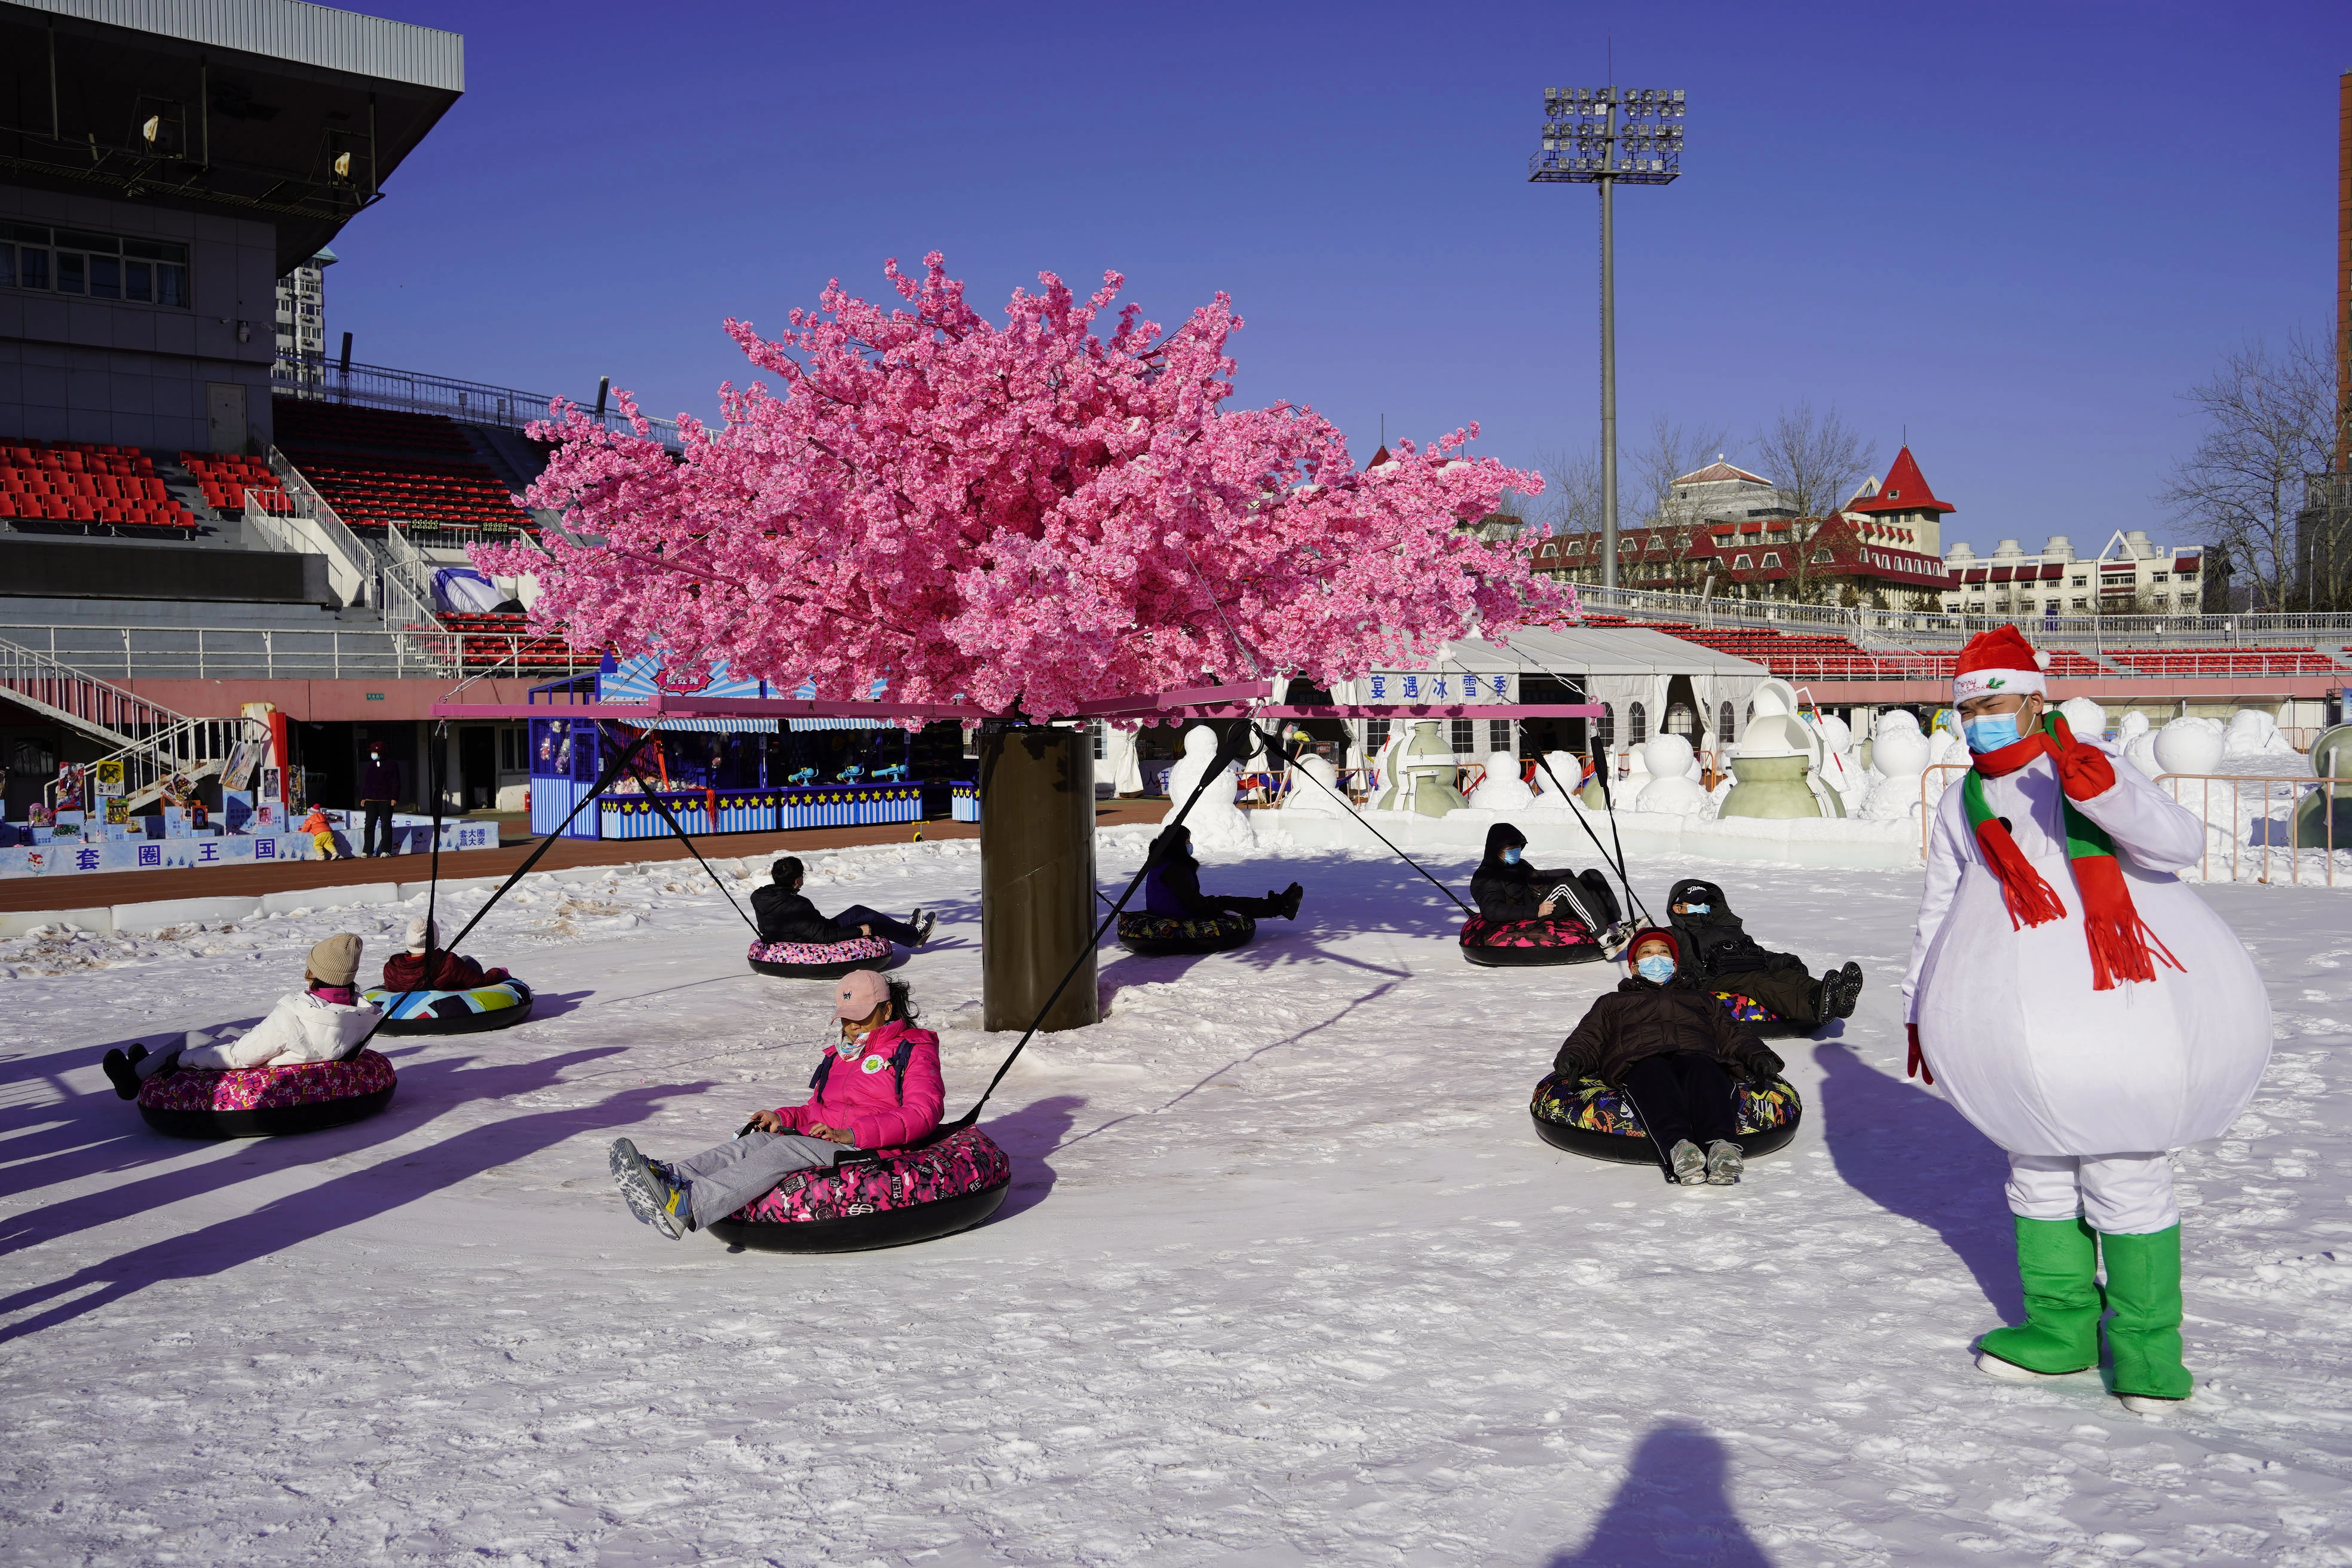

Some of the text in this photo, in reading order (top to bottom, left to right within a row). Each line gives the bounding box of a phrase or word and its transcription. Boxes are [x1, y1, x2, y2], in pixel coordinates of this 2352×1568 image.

[1371, 675, 1506, 699] 宴遇冰雪季
[460, 829, 485, 838] 套大圈
[460, 837, 485, 847] 赢大奖
[76, 838, 275, 870] 套圈王国
[892, 1176, 902, 1199] PLEIN
